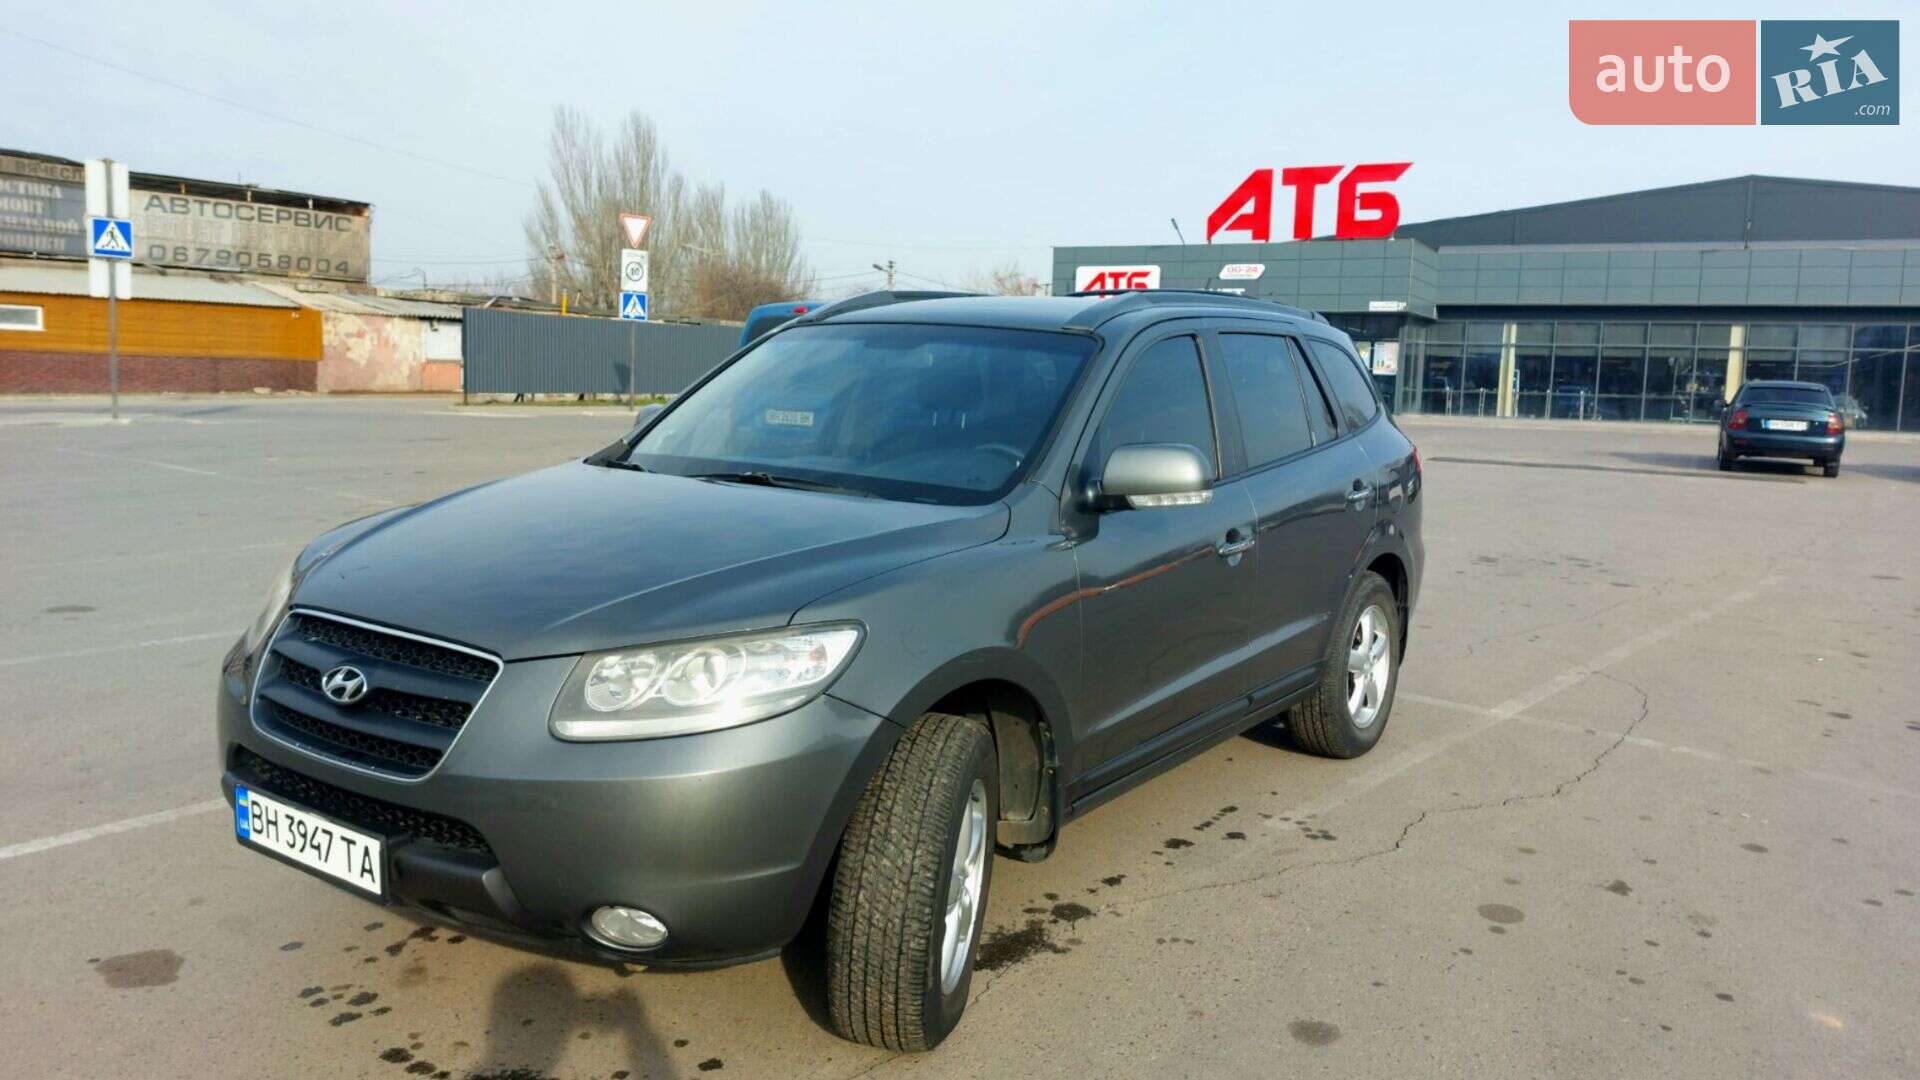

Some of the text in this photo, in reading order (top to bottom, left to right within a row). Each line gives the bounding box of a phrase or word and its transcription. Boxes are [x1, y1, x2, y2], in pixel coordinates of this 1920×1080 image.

[144, 194, 353, 233] АВТОСЕРВИС
[1206, 162, 1413, 241] АТБ
[148, 244, 350, 276] 0679058004
[1083, 271, 1151, 293] АТБ
[251, 800, 376, 884] BH 3947 TA
